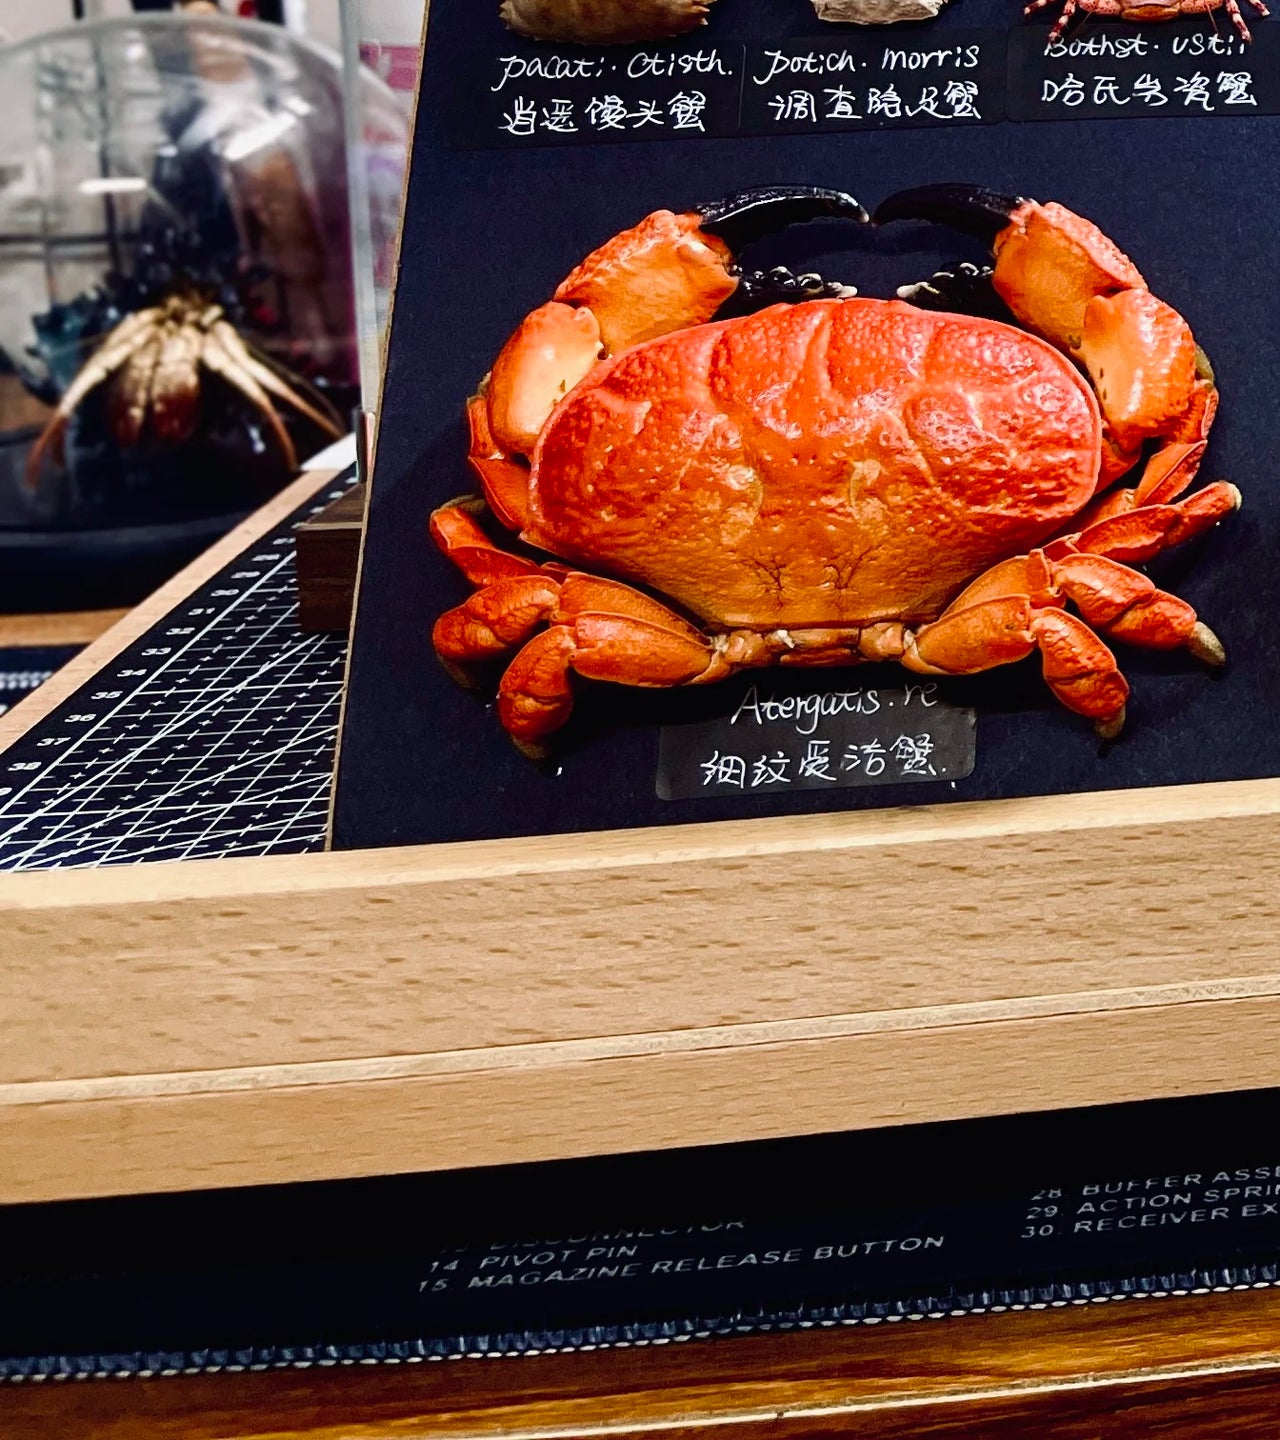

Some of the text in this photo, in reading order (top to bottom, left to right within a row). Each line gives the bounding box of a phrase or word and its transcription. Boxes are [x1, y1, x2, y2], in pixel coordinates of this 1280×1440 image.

[498, 90, 707, 135] 逍遥馒头蟹
[91, 691, 123, 700] 35
[65, 714, 96, 723] 36
[37, 737, 71, 747] 37
[1082, 1173, 1202, 1197] BUFFER
[1076, 1192, 1192, 1215] ACTION
[1073, 1207, 1230, 1234] RECEIVER
[467, 1263, 642, 1289] MAGAZINE
[650, 1248, 803, 1274] RELEASE
[813, 1236, 945, 1260] BUTTON
[480, 1249, 572, 1269] PIVOT
[587, 1245, 639, 1261] PIN
